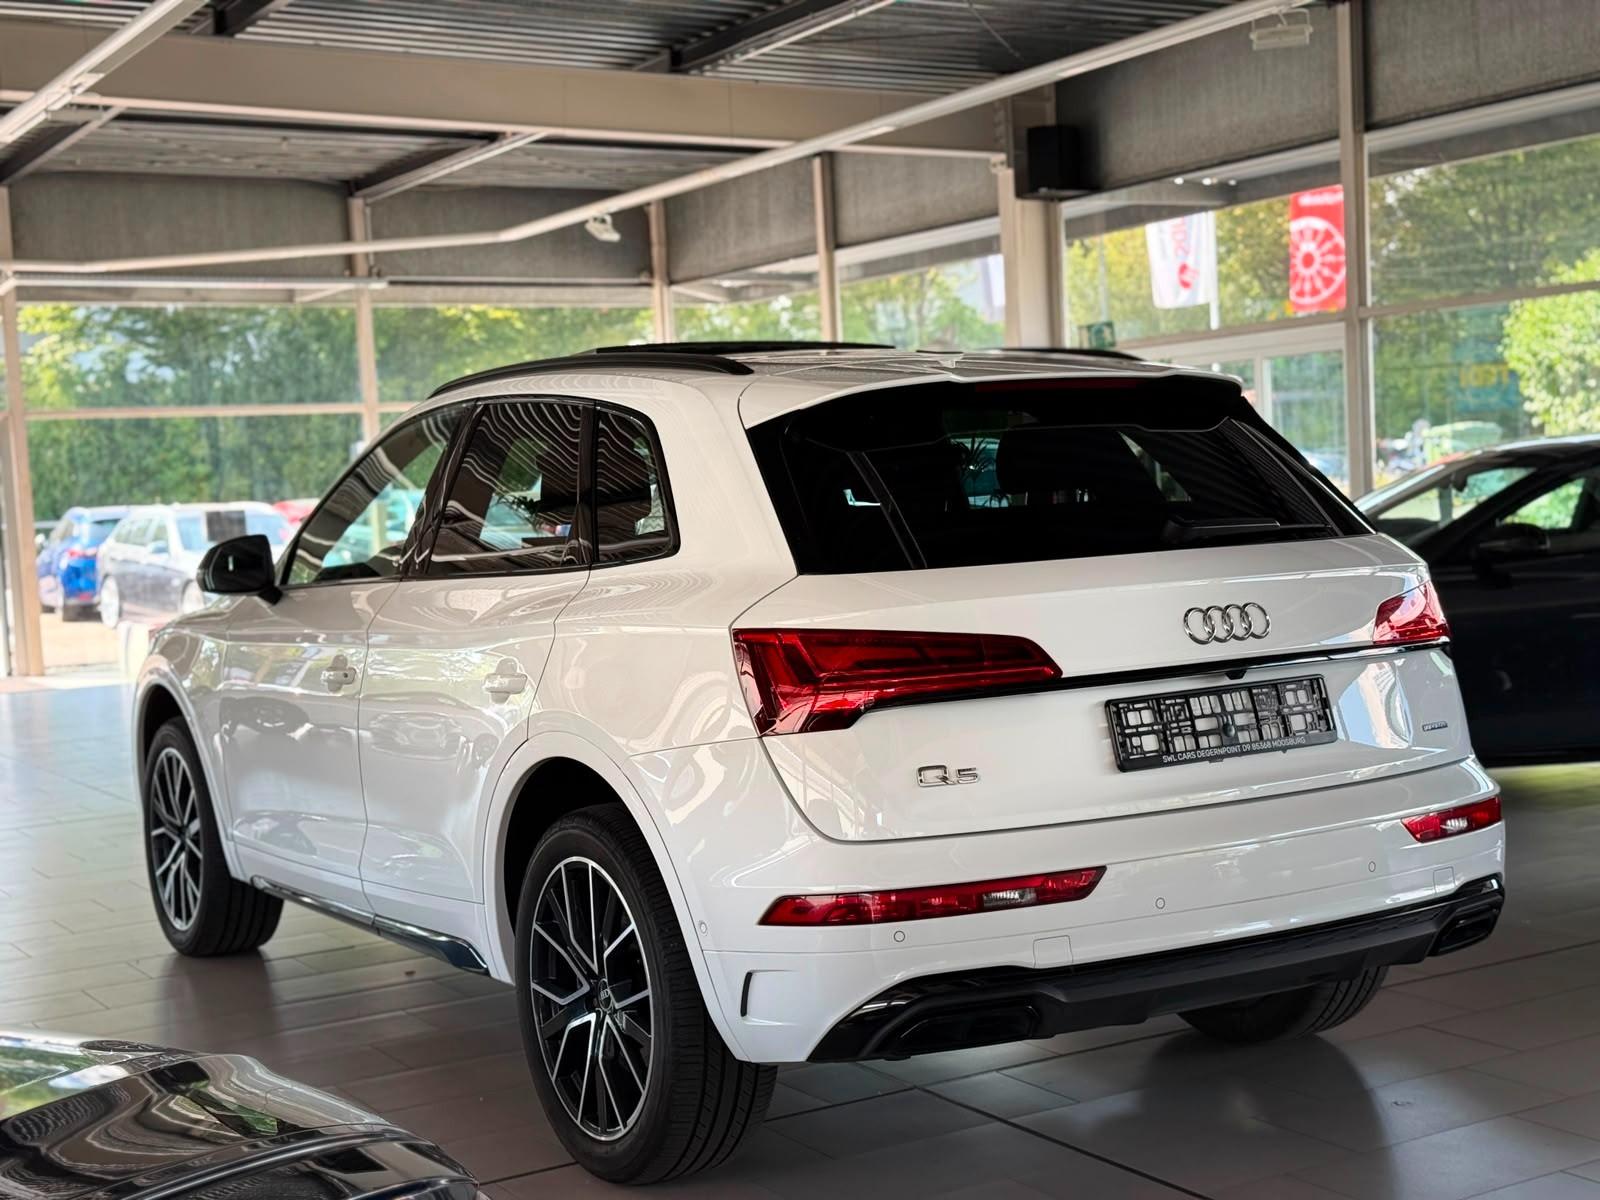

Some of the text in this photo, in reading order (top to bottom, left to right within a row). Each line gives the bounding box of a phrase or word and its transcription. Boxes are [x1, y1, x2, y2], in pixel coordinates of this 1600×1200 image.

[1162, 755, 1177, 763] SWL
[1177, 751, 1196, 761] CARS
[1197, 746, 1241, 758] DEGERNPOINT
[1251, 741, 1272, 751] 85368
[1271, 737, 1306, 748] MOOSBURG
[917, 764, 978, 787] Q5
